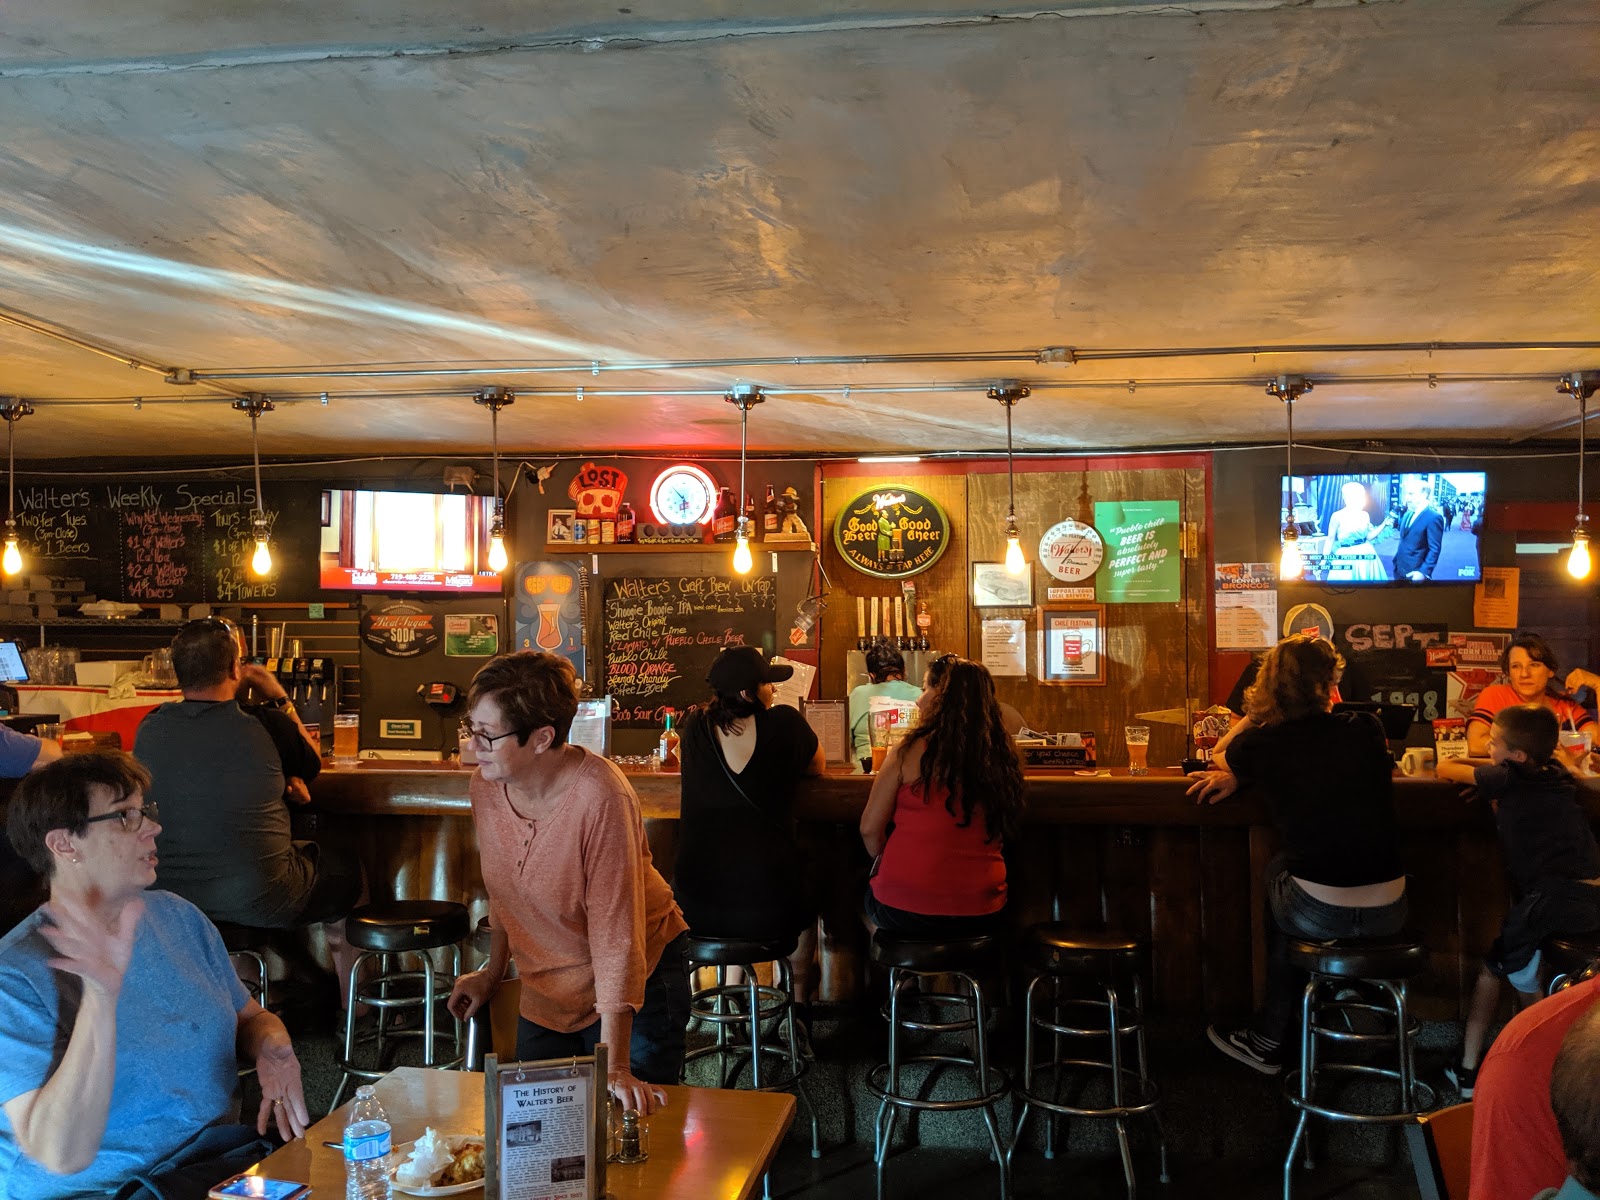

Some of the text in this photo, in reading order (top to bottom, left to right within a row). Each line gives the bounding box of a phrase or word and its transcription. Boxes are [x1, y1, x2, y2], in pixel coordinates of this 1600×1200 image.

[579, 469, 619, 488] LOST
[18, 484, 256, 515] Walter's Weekly Specials
[848, 517, 931, 532] Good Good
[127, 535, 140, 549] $1
[842, 530, 940, 545] Beer Cheer
[1120, 530, 1156, 546] BEER IS
[45, 540, 52, 555] 1
[55, 540, 90, 554] Beers
[213, 540, 227, 556] $1
[1117, 541, 1159, 556] absolutely
[848, 549, 884, 571] ALWAYS
[897, 560, 913, 571] TAP
[914, 546, 935, 565] HERE
[1108, 548, 1168, 569] PERFECT AND
[127, 562, 142, 578] $2
[216, 567, 231, 583] $2
[1058, 566, 1080, 575] BEER
[1113, 567, 1135, 578] super
[217, 582, 233, 600] $4
[237, 582, 277, 600] TOWERS
[613, 578, 671, 600] Walter's
[679, 577, 705, 594] Craft
[707, 577, 731, 600] Brew
[676, 601, 693, 615] IPA
[607, 620, 639, 631] Walter's
[390, 628, 416, 643] SODA
[609, 629, 630, 643] Red
[661, 626, 687, 635] Lime
[663, 634, 694, 648] PUEBLO
[723, 628, 745, 646] BEER
[1345, 624, 1440, 651] SEPT
[524, 638, 574, 647] 3 1
[607, 650, 638, 665] Pueblo
[608, 661, 677, 675] BLOOD ORANGE
[607, 683, 636, 697] Coffee
[634, 705, 653, 721] Sour
[513, 1088, 530, 1099] THE
[533, 1086, 564, 1097] HISTORY
[516, 1095, 574, 1108] WALTER'S BEER
